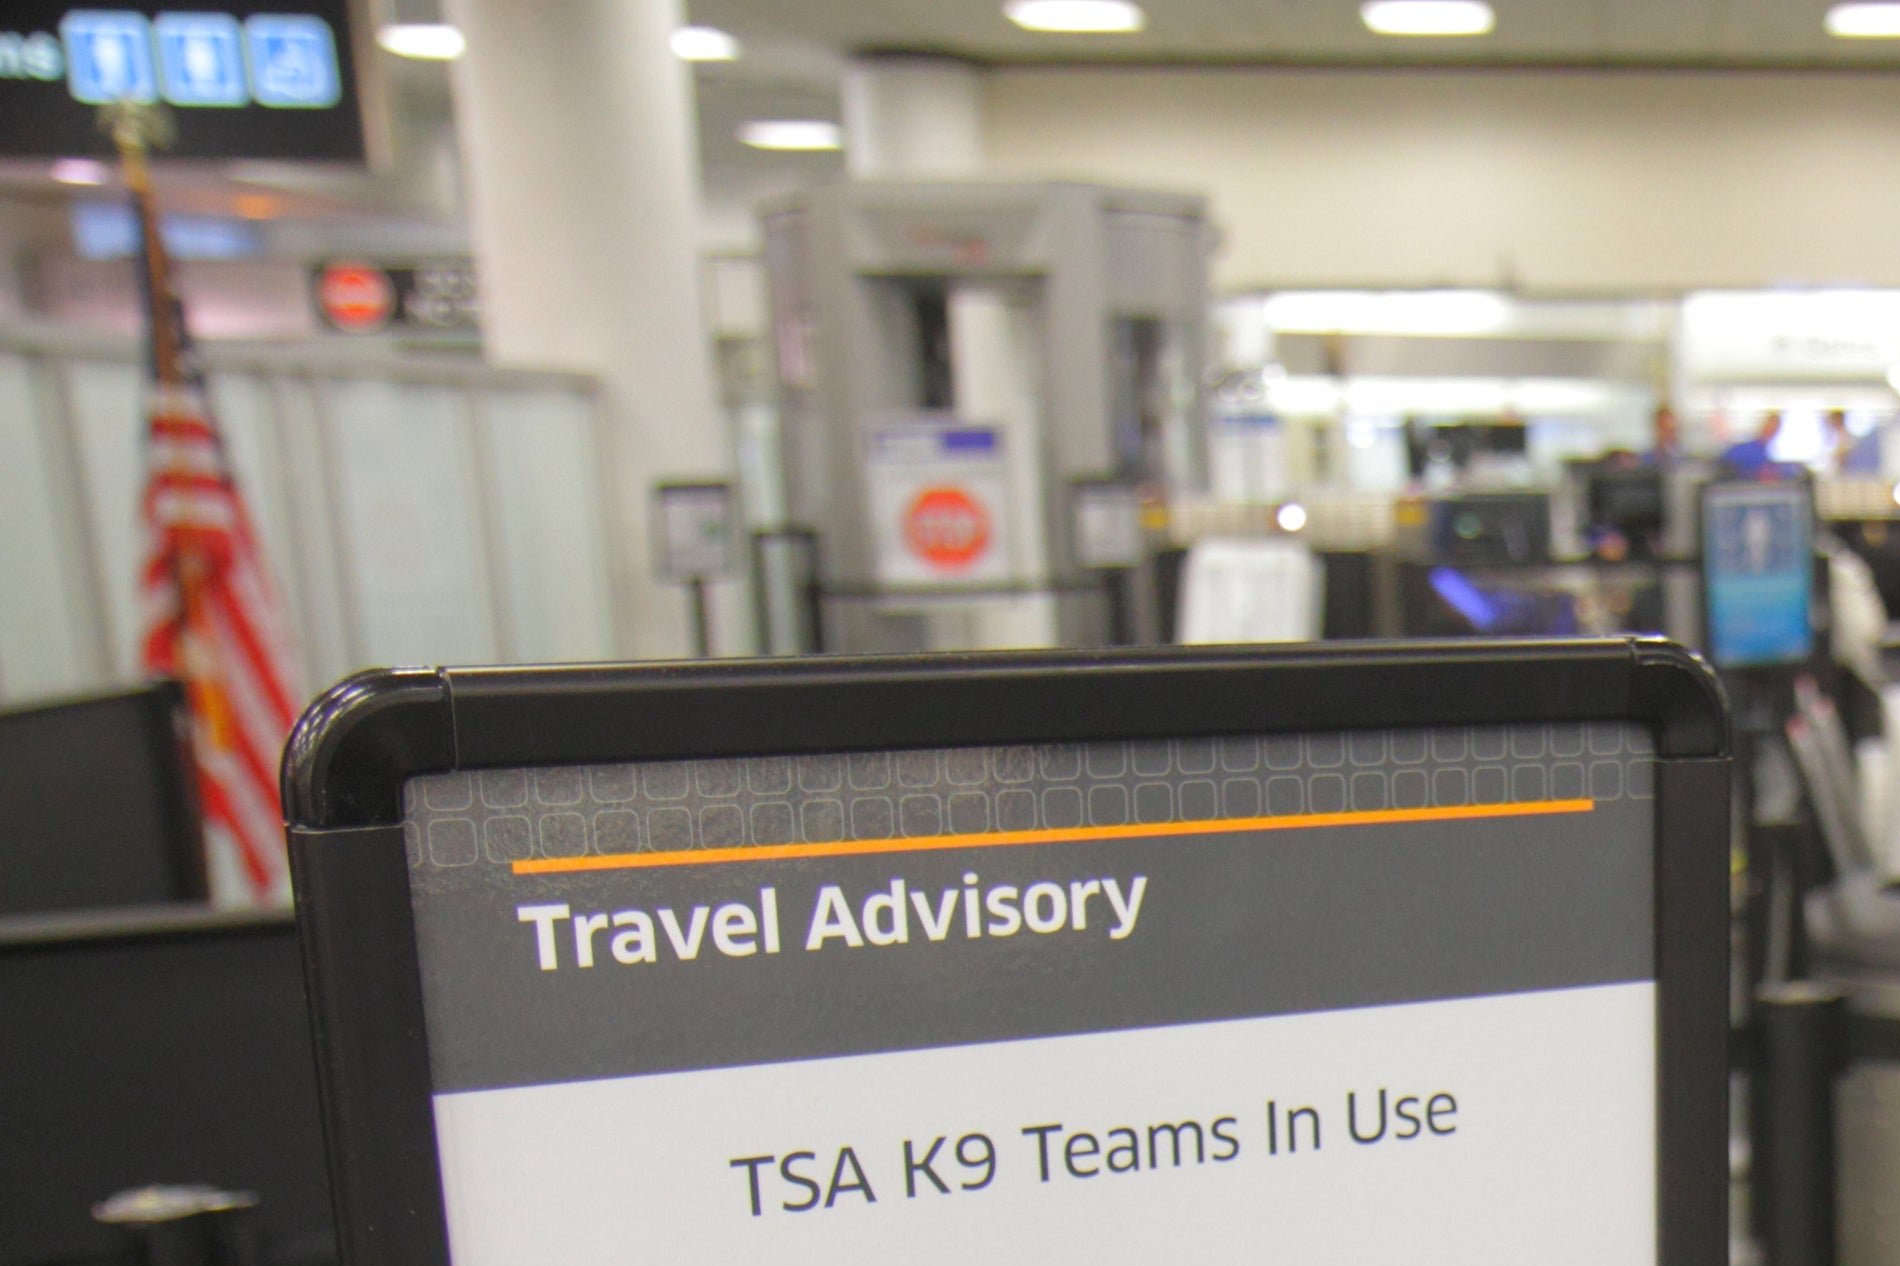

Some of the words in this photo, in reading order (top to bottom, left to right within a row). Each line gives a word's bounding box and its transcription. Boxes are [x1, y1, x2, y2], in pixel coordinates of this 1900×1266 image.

[515, 886, 781, 971] Travel
[804, 871, 1149, 951] Advisory
[729, 1146, 877, 1217] TSA
[902, 1132, 997, 1198] K9
[1020, 1115, 1241, 1183] Teams
[1264, 1099, 1322, 1155] In
[1345, 1088, 1459, 1144] Use
